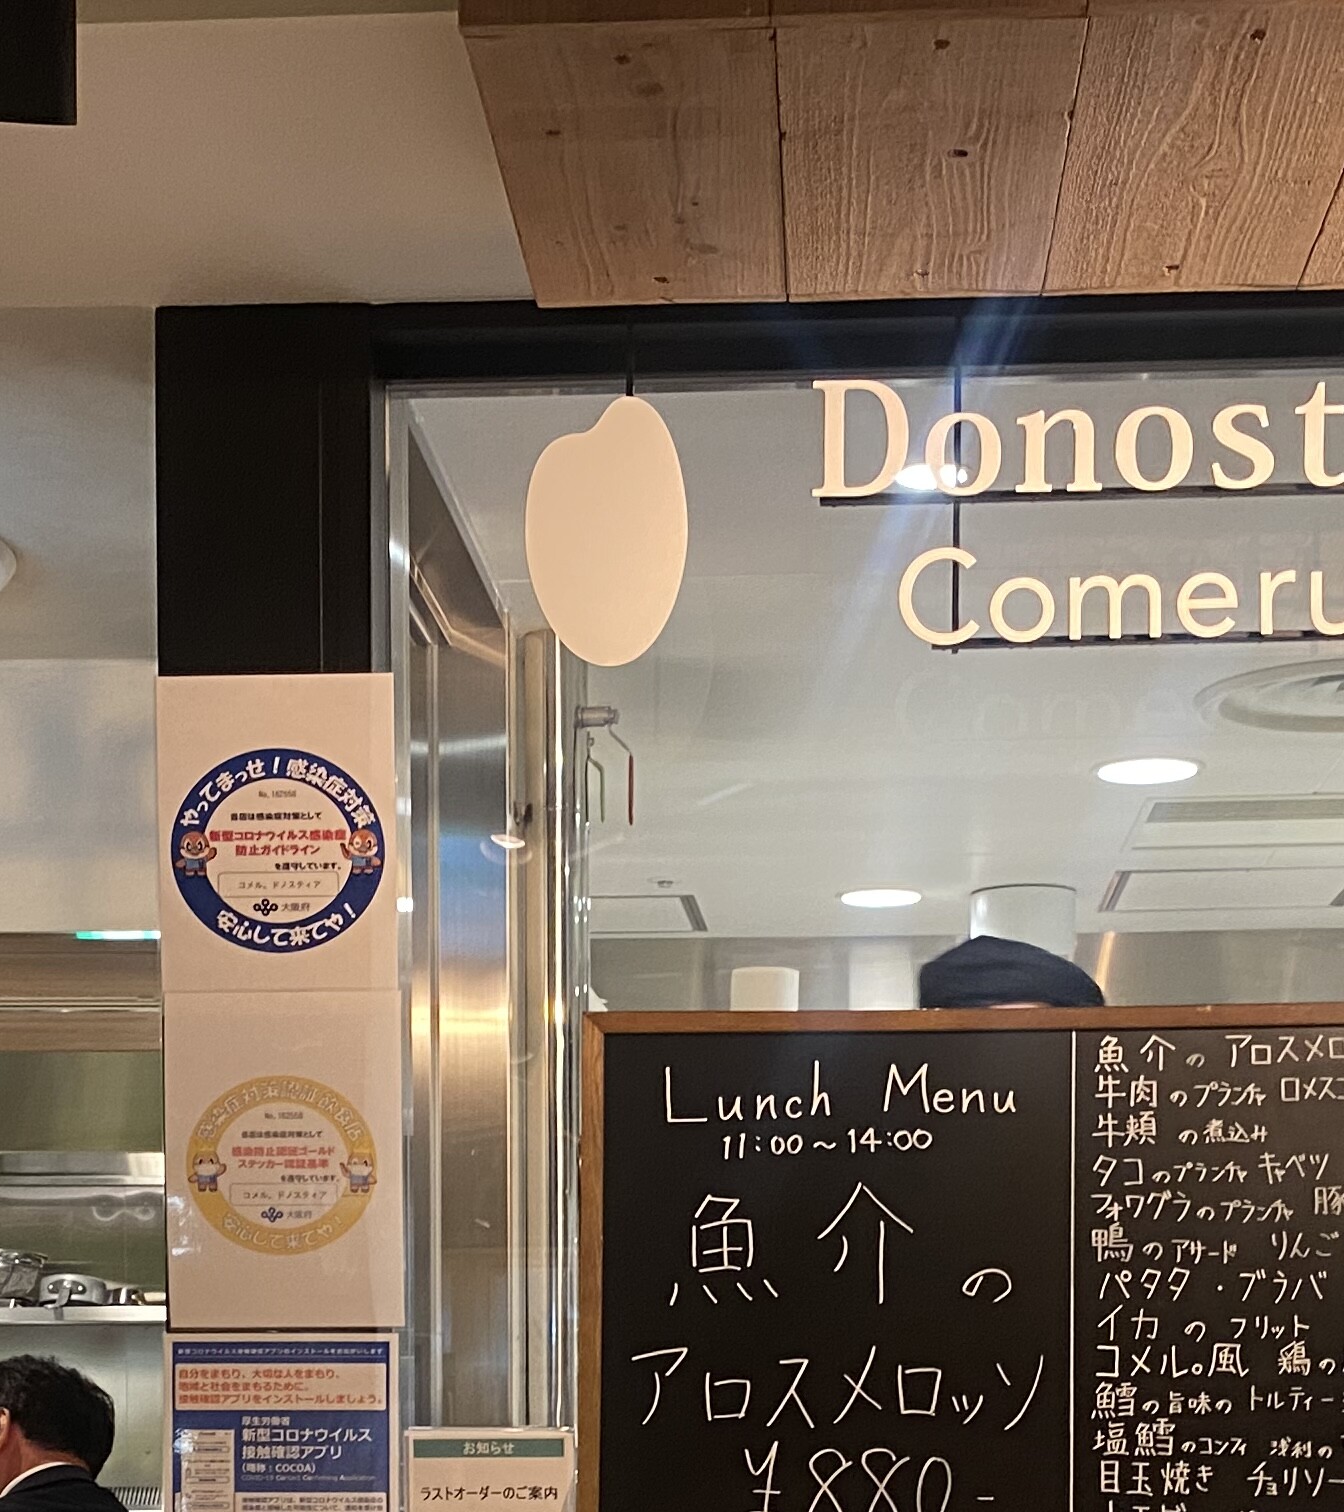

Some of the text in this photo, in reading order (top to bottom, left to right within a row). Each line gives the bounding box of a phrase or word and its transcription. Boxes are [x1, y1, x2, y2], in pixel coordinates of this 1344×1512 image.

[665, 1059, 1016, 1123] Lunch Menu
[630, 1345, 1045, 1432] アロスメロッソ
[241, 1427, 372, 1442] 新型コロナウイルス
[241, 1445, 342, 1460] 接触確認アプリ
[463, 1441, 515, 1455] お知らせ
[1099, 1460, 1214, 1497] 目玉焼き
[420, 1485, 558, 1500] ラストオーダーのご案内
